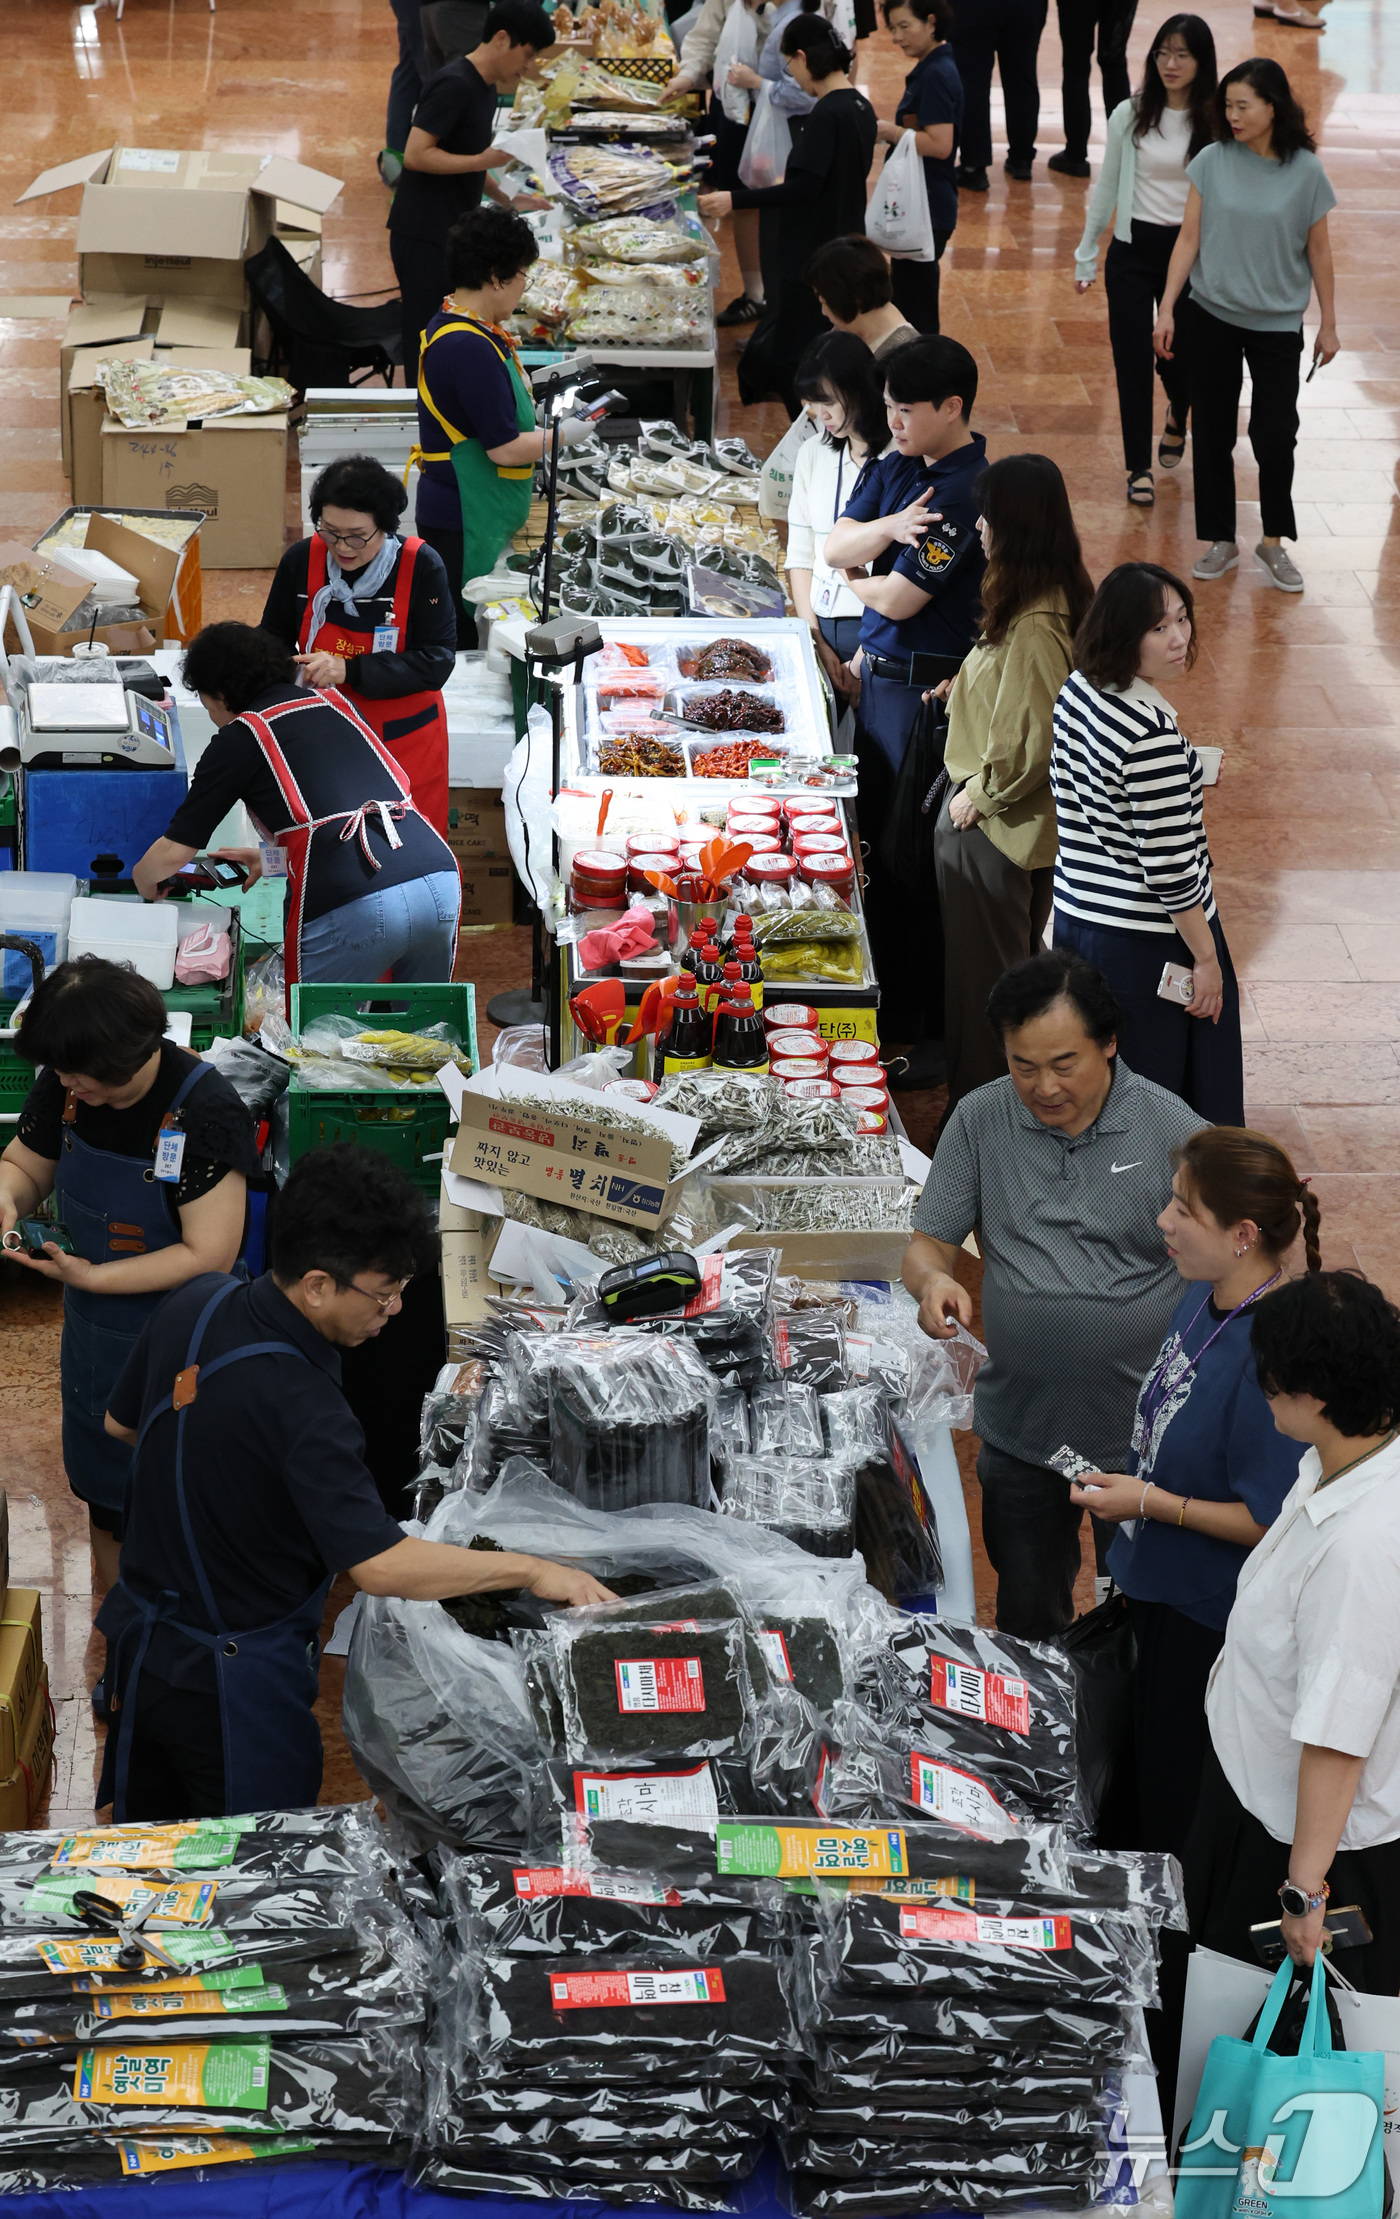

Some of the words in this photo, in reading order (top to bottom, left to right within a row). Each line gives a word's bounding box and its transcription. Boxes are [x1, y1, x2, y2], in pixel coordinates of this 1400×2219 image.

[335, 638, 365, 655] 장성군
[466, 839, 487, 847] CAKE
[491, 1118, 552, 1145] 냉동보관
[162, 1151, 177, 1163] 방문
[163, 1140, 178, 1152] 단체
[476, 1141, 501, 1159] 짜지
[507, 1149, 531, 1167] 않고
[572, 1135, 610, 1159] 멸치
[473, 1155, 510, 1177] 맛있는
[544, 1166, 564, 1181] 명품
[569, 1168, 608, 1197] 멸치
[611, 1182, 626, 1193] NH
[638, 1665, 656, 1708] 다시마채
[960, 1670, 981, 1715] 다시마
[925, 1790, 932, 1802] NH
[950, 1786, 965, 1808] 조각
[890, 1834, 898, 1845] NH
[90, 1840, 120, 1862] 옛날
[118, 1840, 147, 1863] 미역
[814, 1838, 840, 1869] 미역
[840, 1837, 872, 1869] 옛날
[593, 1875, 616, 1897] 미역
[981, 1919, 1005, 1942] 미역
[1007, 1927, 1030, 1940] 참
[633, 1975, 657, 2001] 미역
[659, 1982, 682, 1994] 참
[100, 2005, 112, 2017] NH
[112, 2054, 142, 2095] 옛날
[143, 2055, 173, 2094] 미역
[81, 2083, 92, 2098] NH
[129, 2153, 140, 2168] NH
[1238, 2197, 1268, 2210] GREEN
